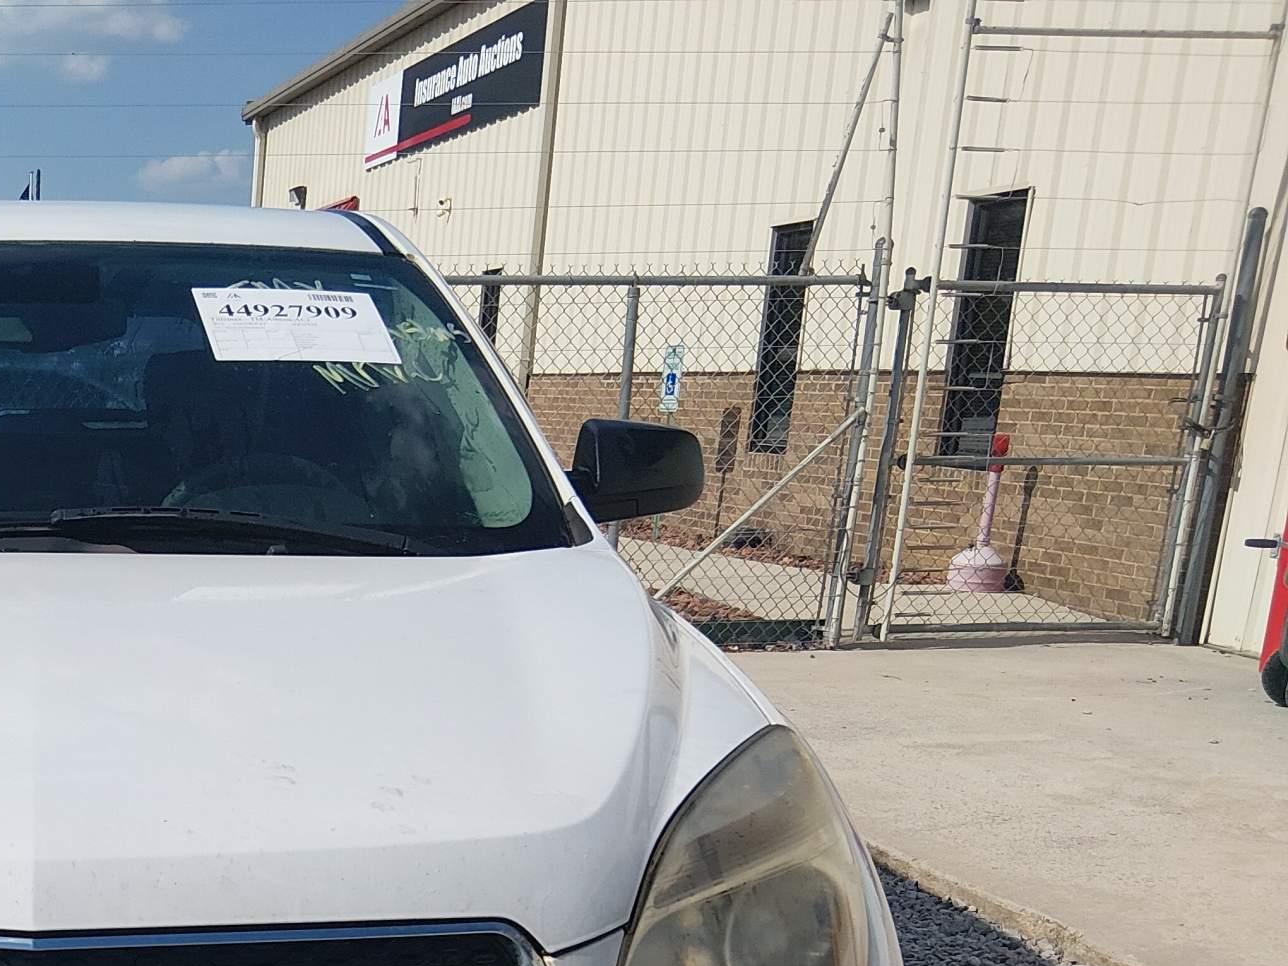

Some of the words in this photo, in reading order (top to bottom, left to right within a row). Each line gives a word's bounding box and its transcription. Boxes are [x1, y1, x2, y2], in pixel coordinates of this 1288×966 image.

[414, 64, 456, 108] Insurance
[456, 53, 479, 88] Auto
[478, 31, 524, 79] Auctions
[219, 303, 358, 320] 44927909
